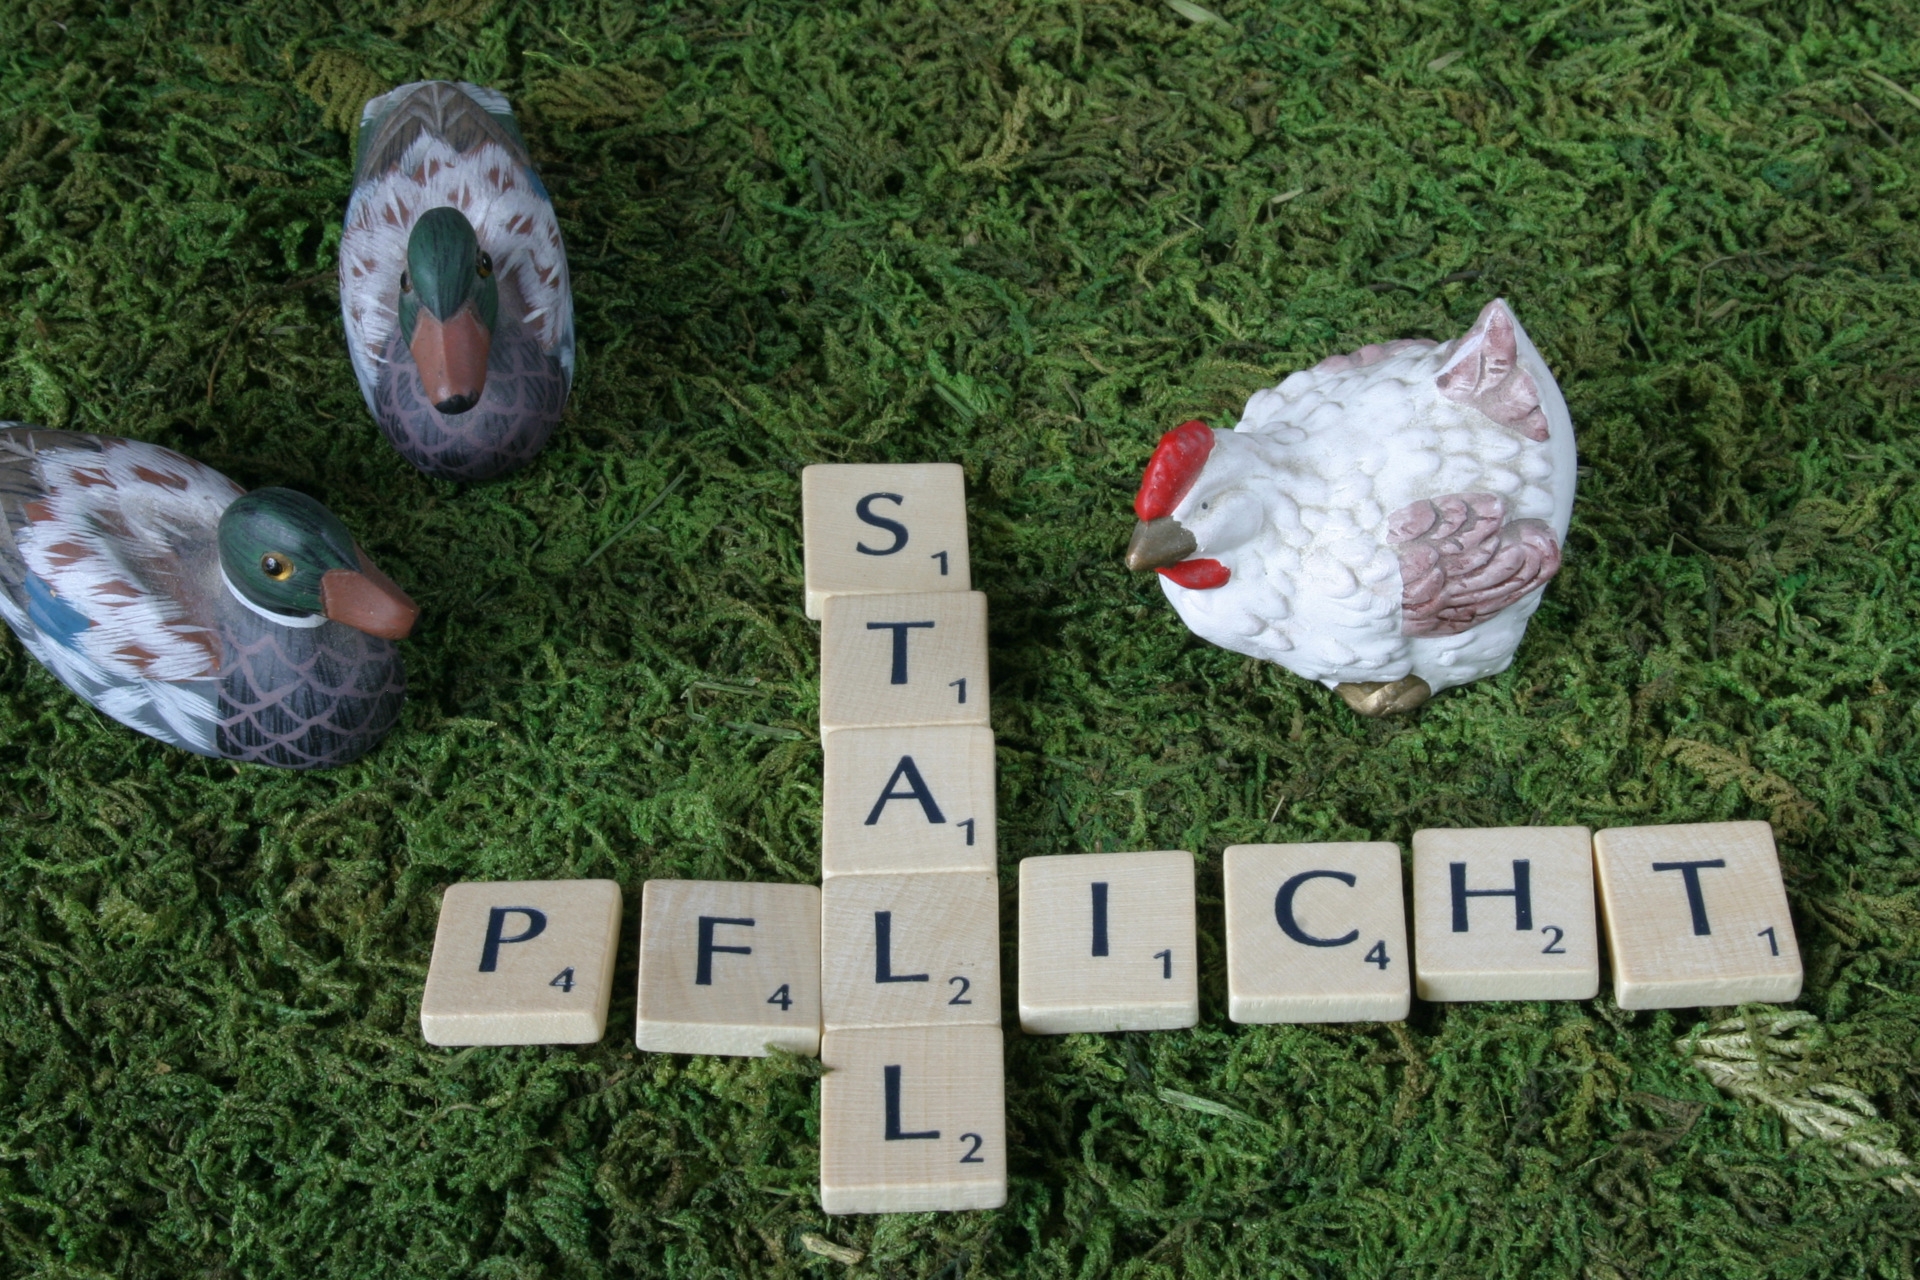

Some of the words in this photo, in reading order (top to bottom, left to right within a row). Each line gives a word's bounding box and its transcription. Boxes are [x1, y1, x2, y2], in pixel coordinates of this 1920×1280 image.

[930, 550, 949, 576] 1
[948, 677, 967, 704] 1
[956, 818, 975, 846] 1
[1541, 926, 1566, 954] 2
[1756, 926, 1780, 957] 1
[1152, 949, 1173, 979] 1
[1363, 940, 1391, 970] 4
[548, 966, 576, 993] 4
[948, 976, 972, 1006] 2
[766, 983, 793, 1011] 4
[959, 1132, 985, 1164] 2
